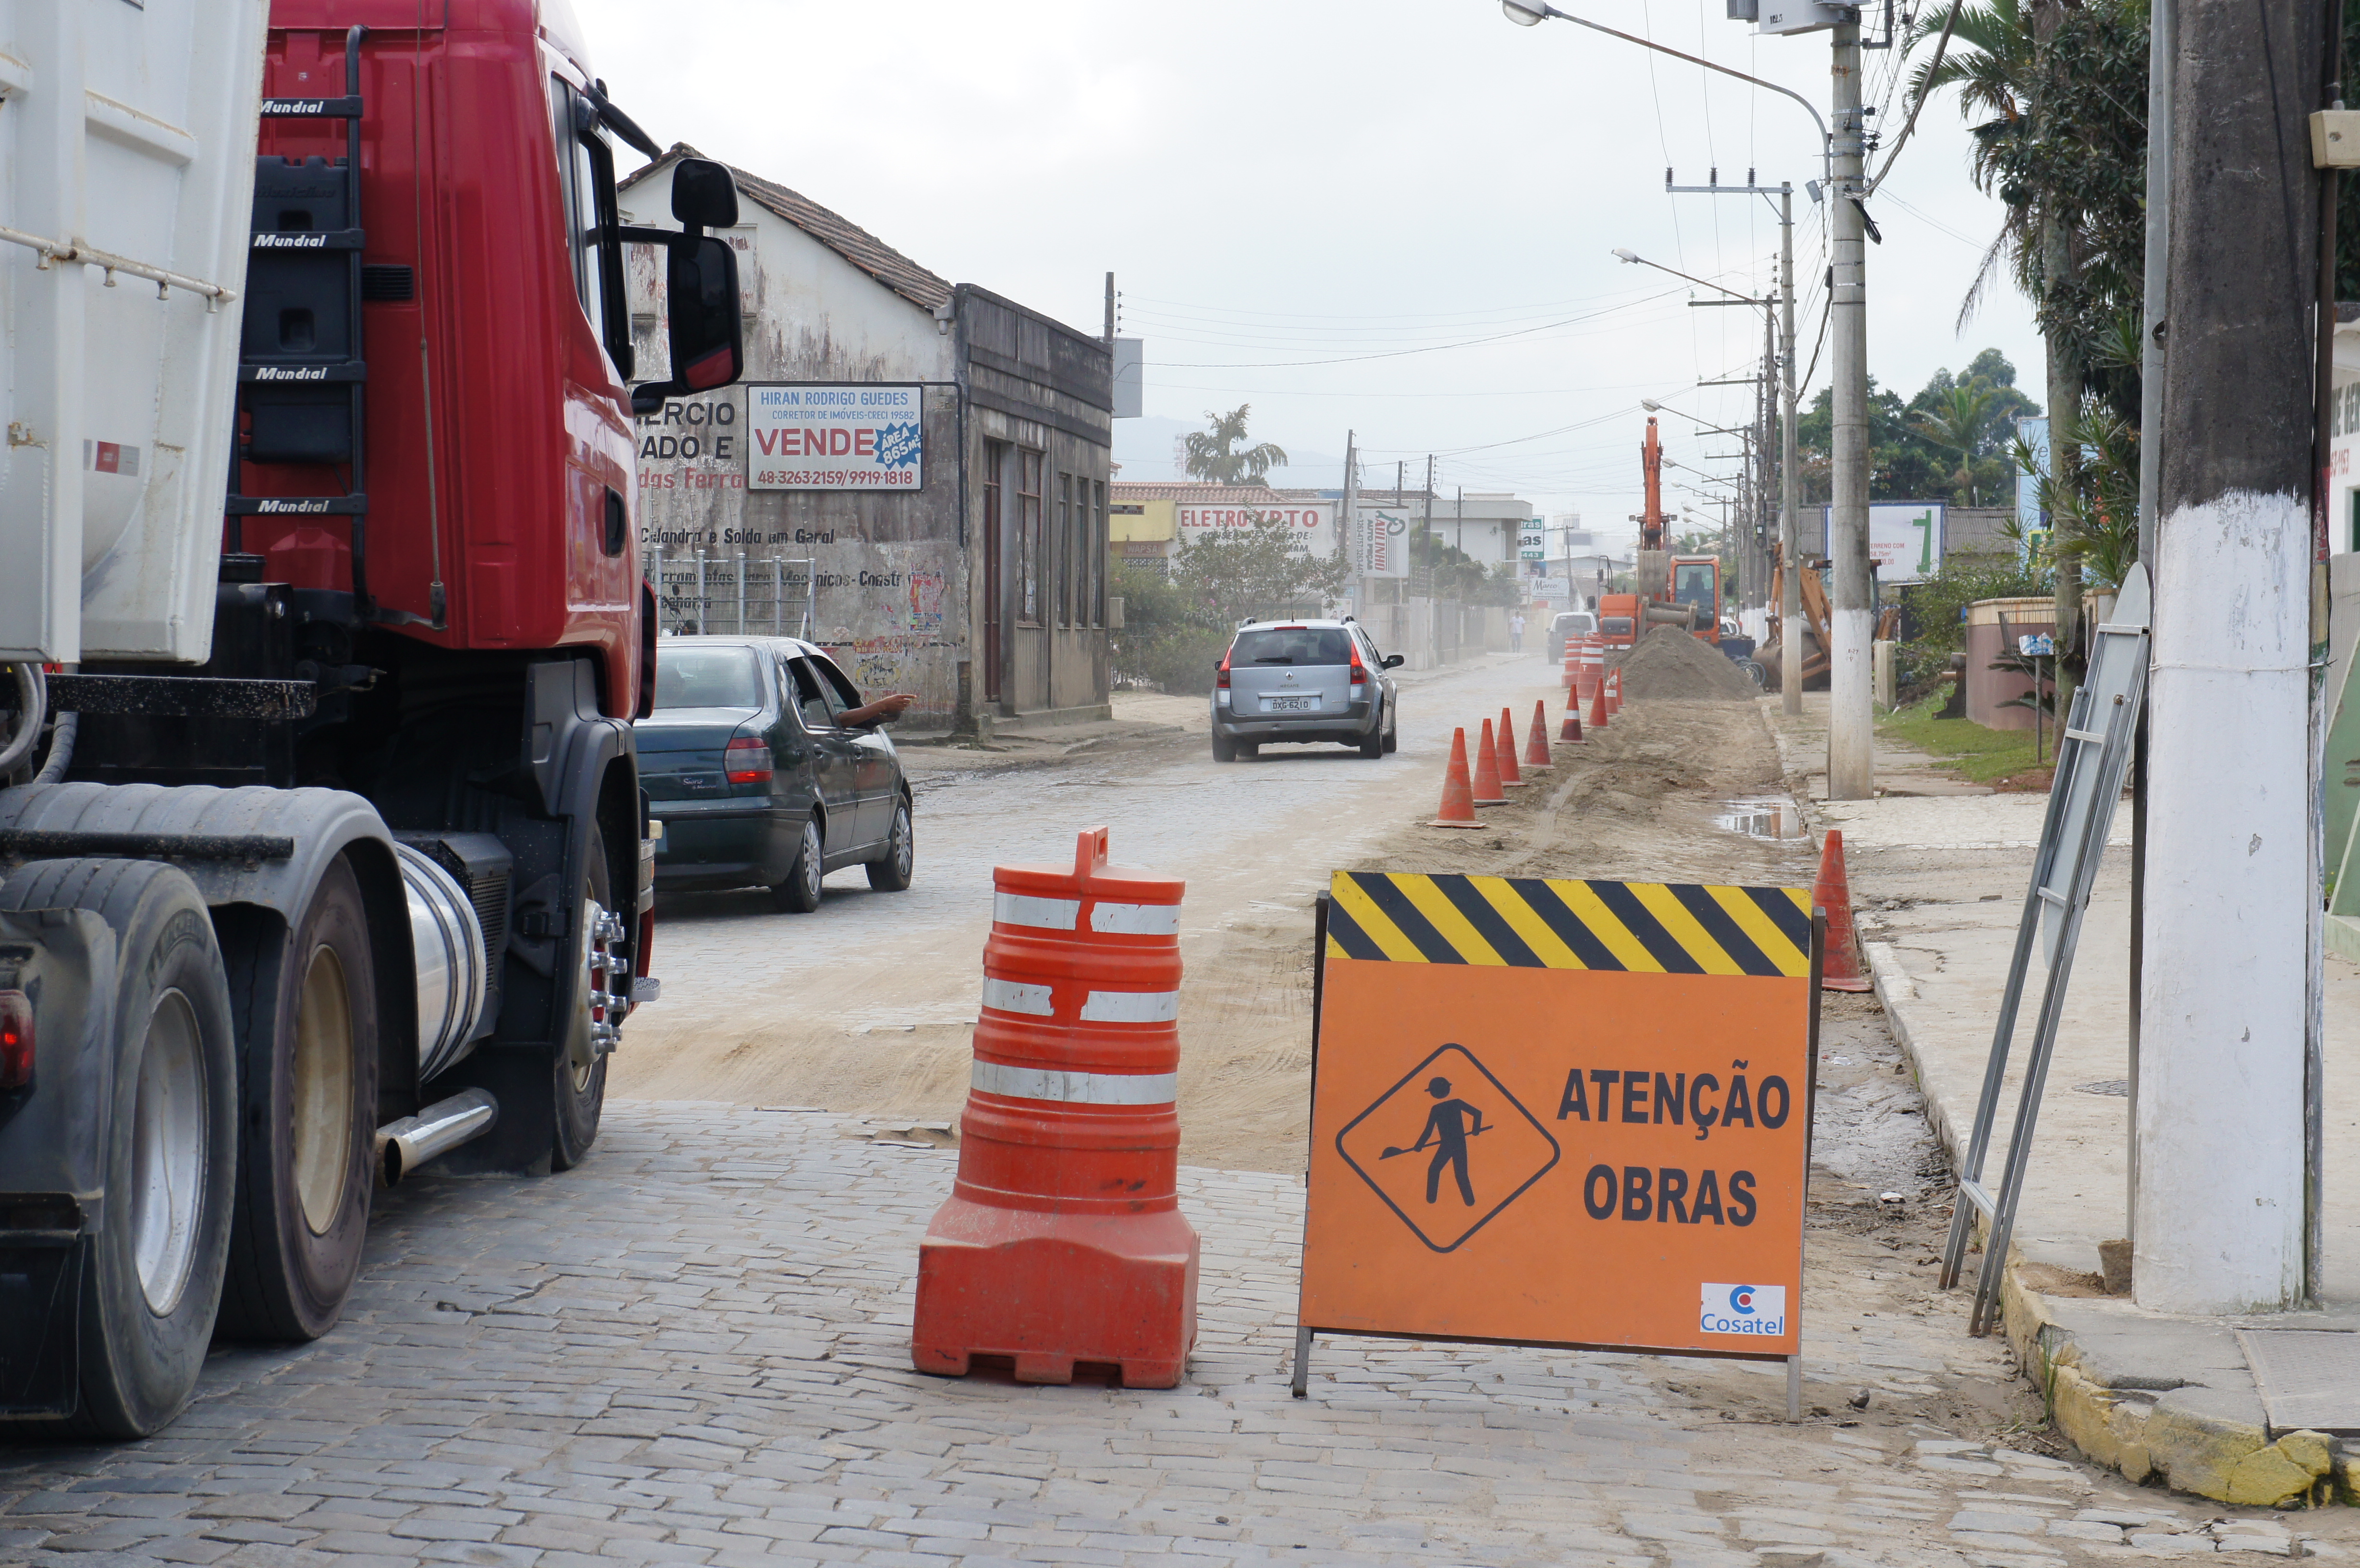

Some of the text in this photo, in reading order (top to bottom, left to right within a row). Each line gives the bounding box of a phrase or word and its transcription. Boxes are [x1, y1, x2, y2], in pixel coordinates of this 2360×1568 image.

[260, 101, 324, 113] Mundial
[254, 234, 327, 247] Mundial
[256, 367, 328, 380] Mundial
[761, 392, 908, 405] HIRAN RODRIGO GUEDES
[772, 410, 815, 419] CORRETOR
[818, 410, 827, 419] DE
[891, 411, 914, 419] 19582
[754, 428, 874, 456] VENDE
[882, 427, 910, 451] ÁREA
[715, 436, 734, 459] E
[258, 500, 330, 512] Mundial
[709, 532, 717, 543] e
[724, 527, 762, 544] Solda
[769, 532, 788, 544] em
[795, 528, 835, 544] Geral
[1127, 545, 1157, 553] WAPSA
[1533, 579, 1557, 590] Marco
[1557, 1059, 1791, 1140] ATENÇÃO
[1584, 1164, 1758, 1227] OBRAS
[1701, 1313, 1783, 1335] Cosatel
